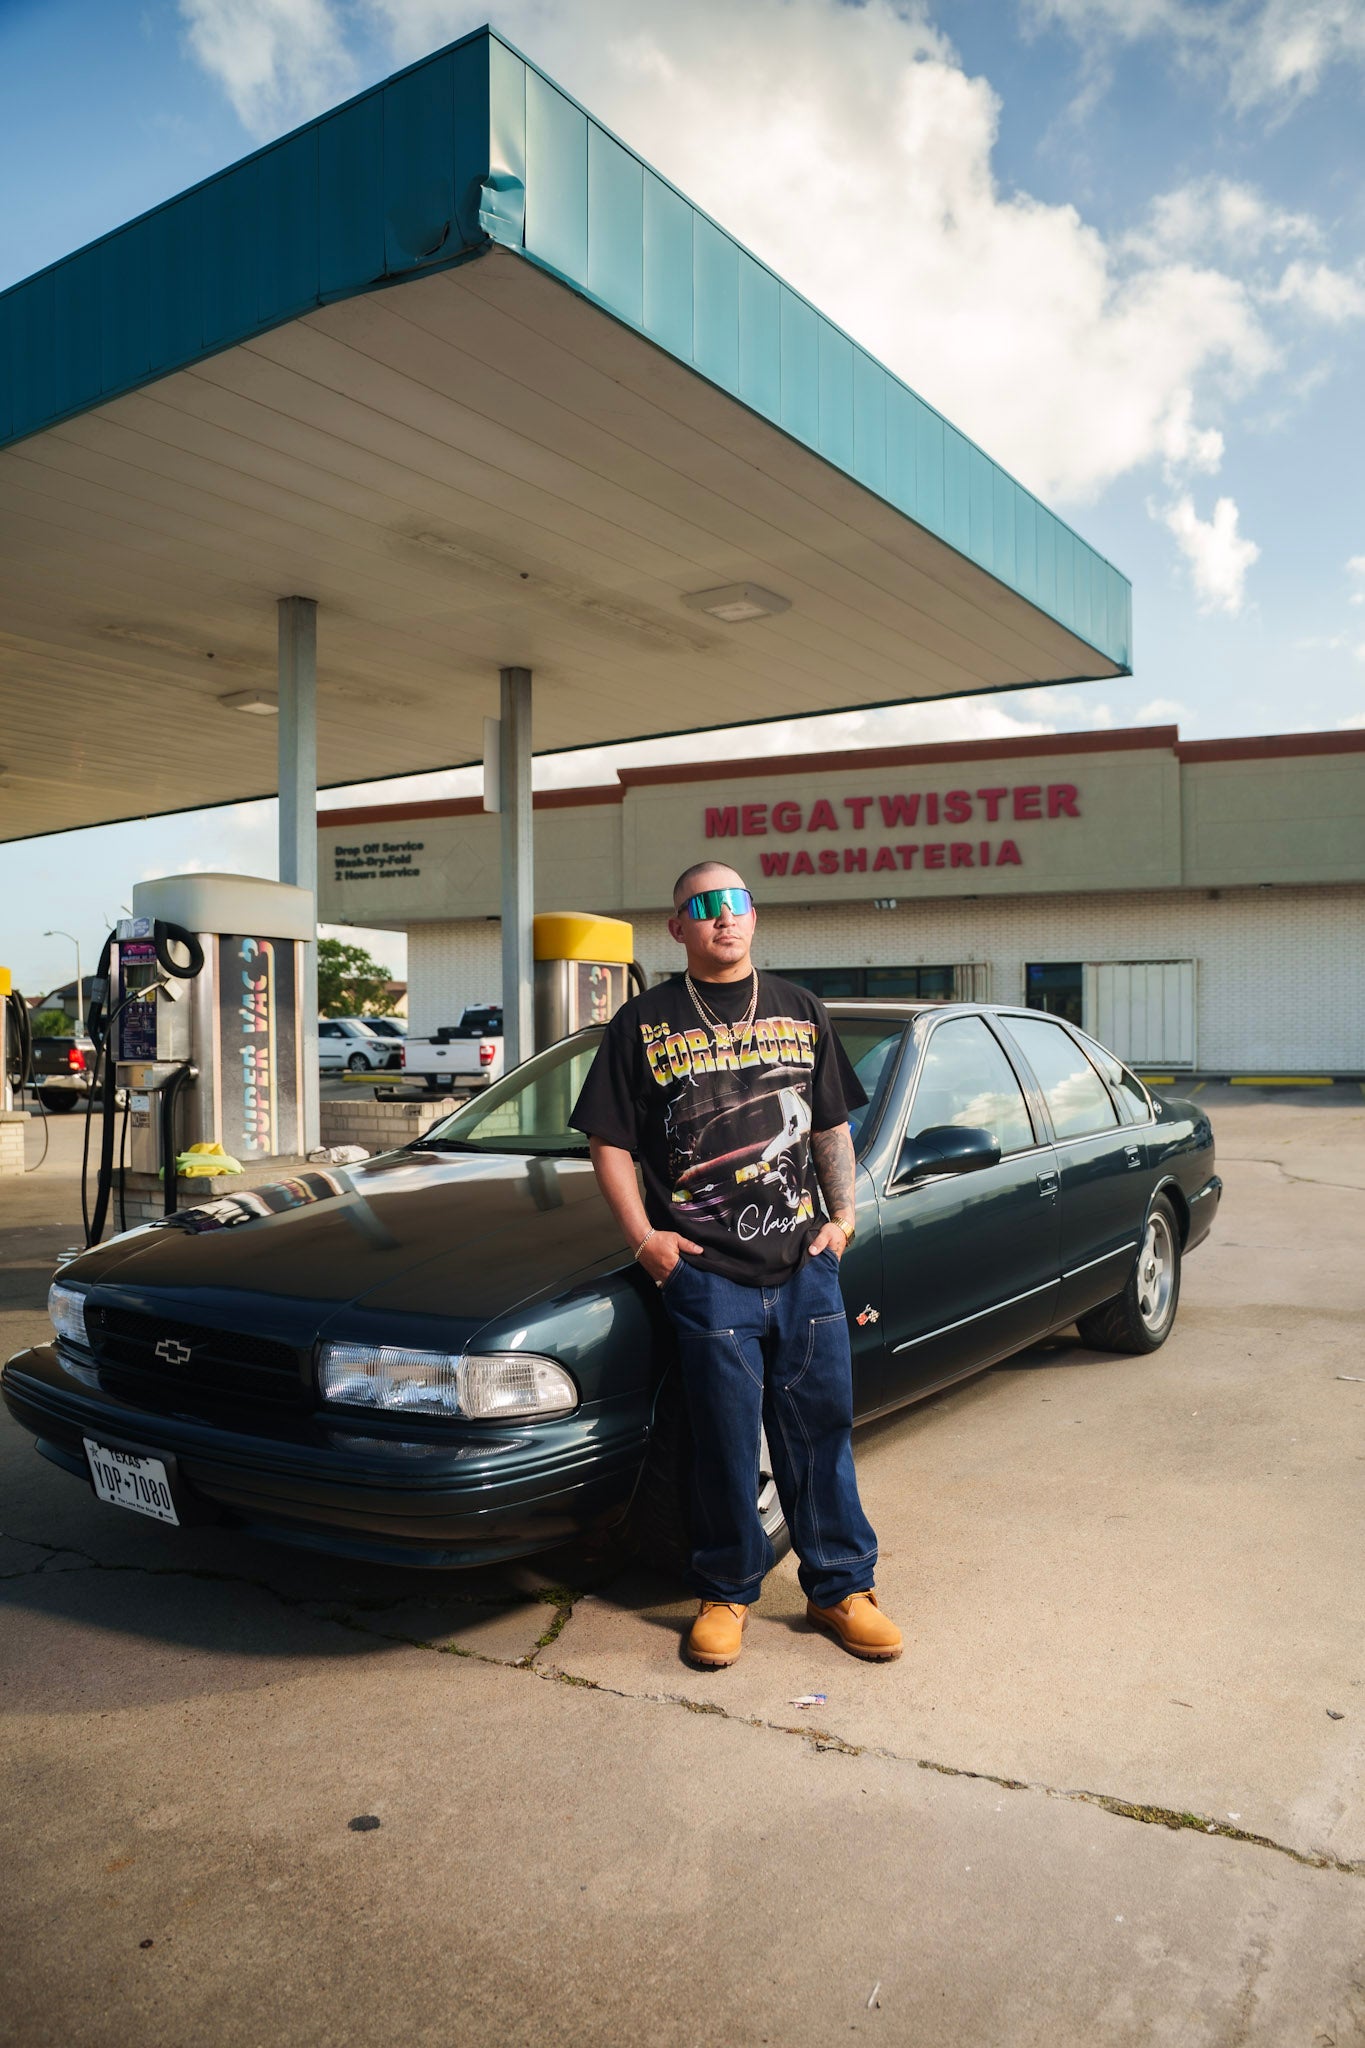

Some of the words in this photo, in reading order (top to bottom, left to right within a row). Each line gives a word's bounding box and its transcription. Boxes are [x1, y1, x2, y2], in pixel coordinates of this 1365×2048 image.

[705, 784, 1081, 838] MEGATWISTER
[335, 846, 360, 857] Drop
[363, 843, 380, 854] Off
[382, 841, 424, 853] Service
[760, 840, 1022, 877] WASHATERIA
[335, 871, 342, 881] 2
[345, 869, 376, 880] Hours
[379, 867, 420, 878] service
[241, 970, 269, 1033] VAC
[591, 990, 607, 1023] AC
[639, 1022, 671, 1044] Dos
[241, 1045, 270, 1152] SUPER
[110, 1450, 142, 1470] TEXAS
